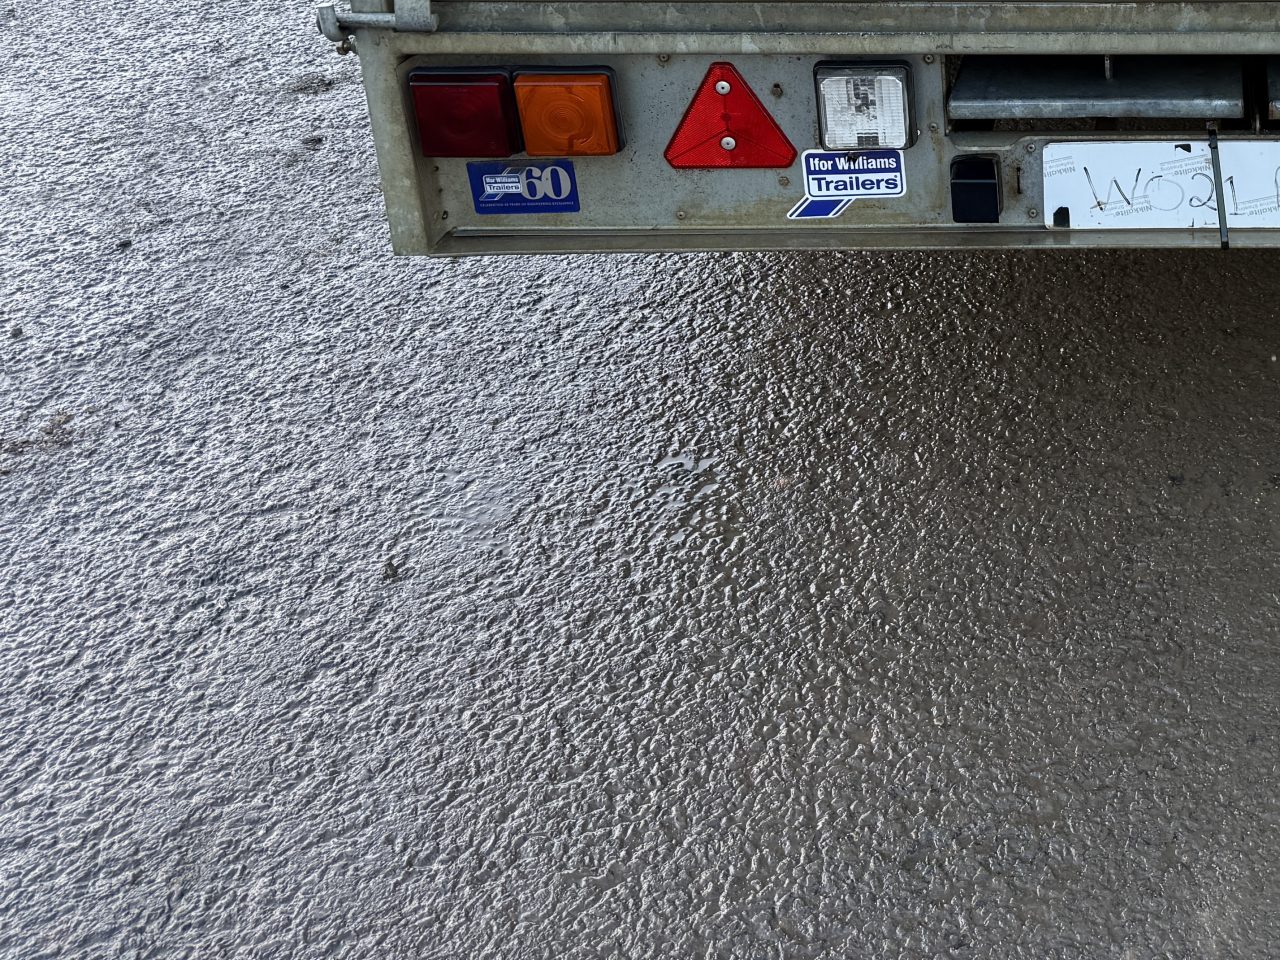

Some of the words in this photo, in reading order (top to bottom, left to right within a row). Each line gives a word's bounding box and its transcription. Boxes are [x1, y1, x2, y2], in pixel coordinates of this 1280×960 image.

[808, 157, 833, 171] Ifor
[834, 156, 897, 171] Williams
[487, 184, 520, 192] Trailers
[520, 166, 572, 200] 60
[811, 176, 898, 192] Trailers
